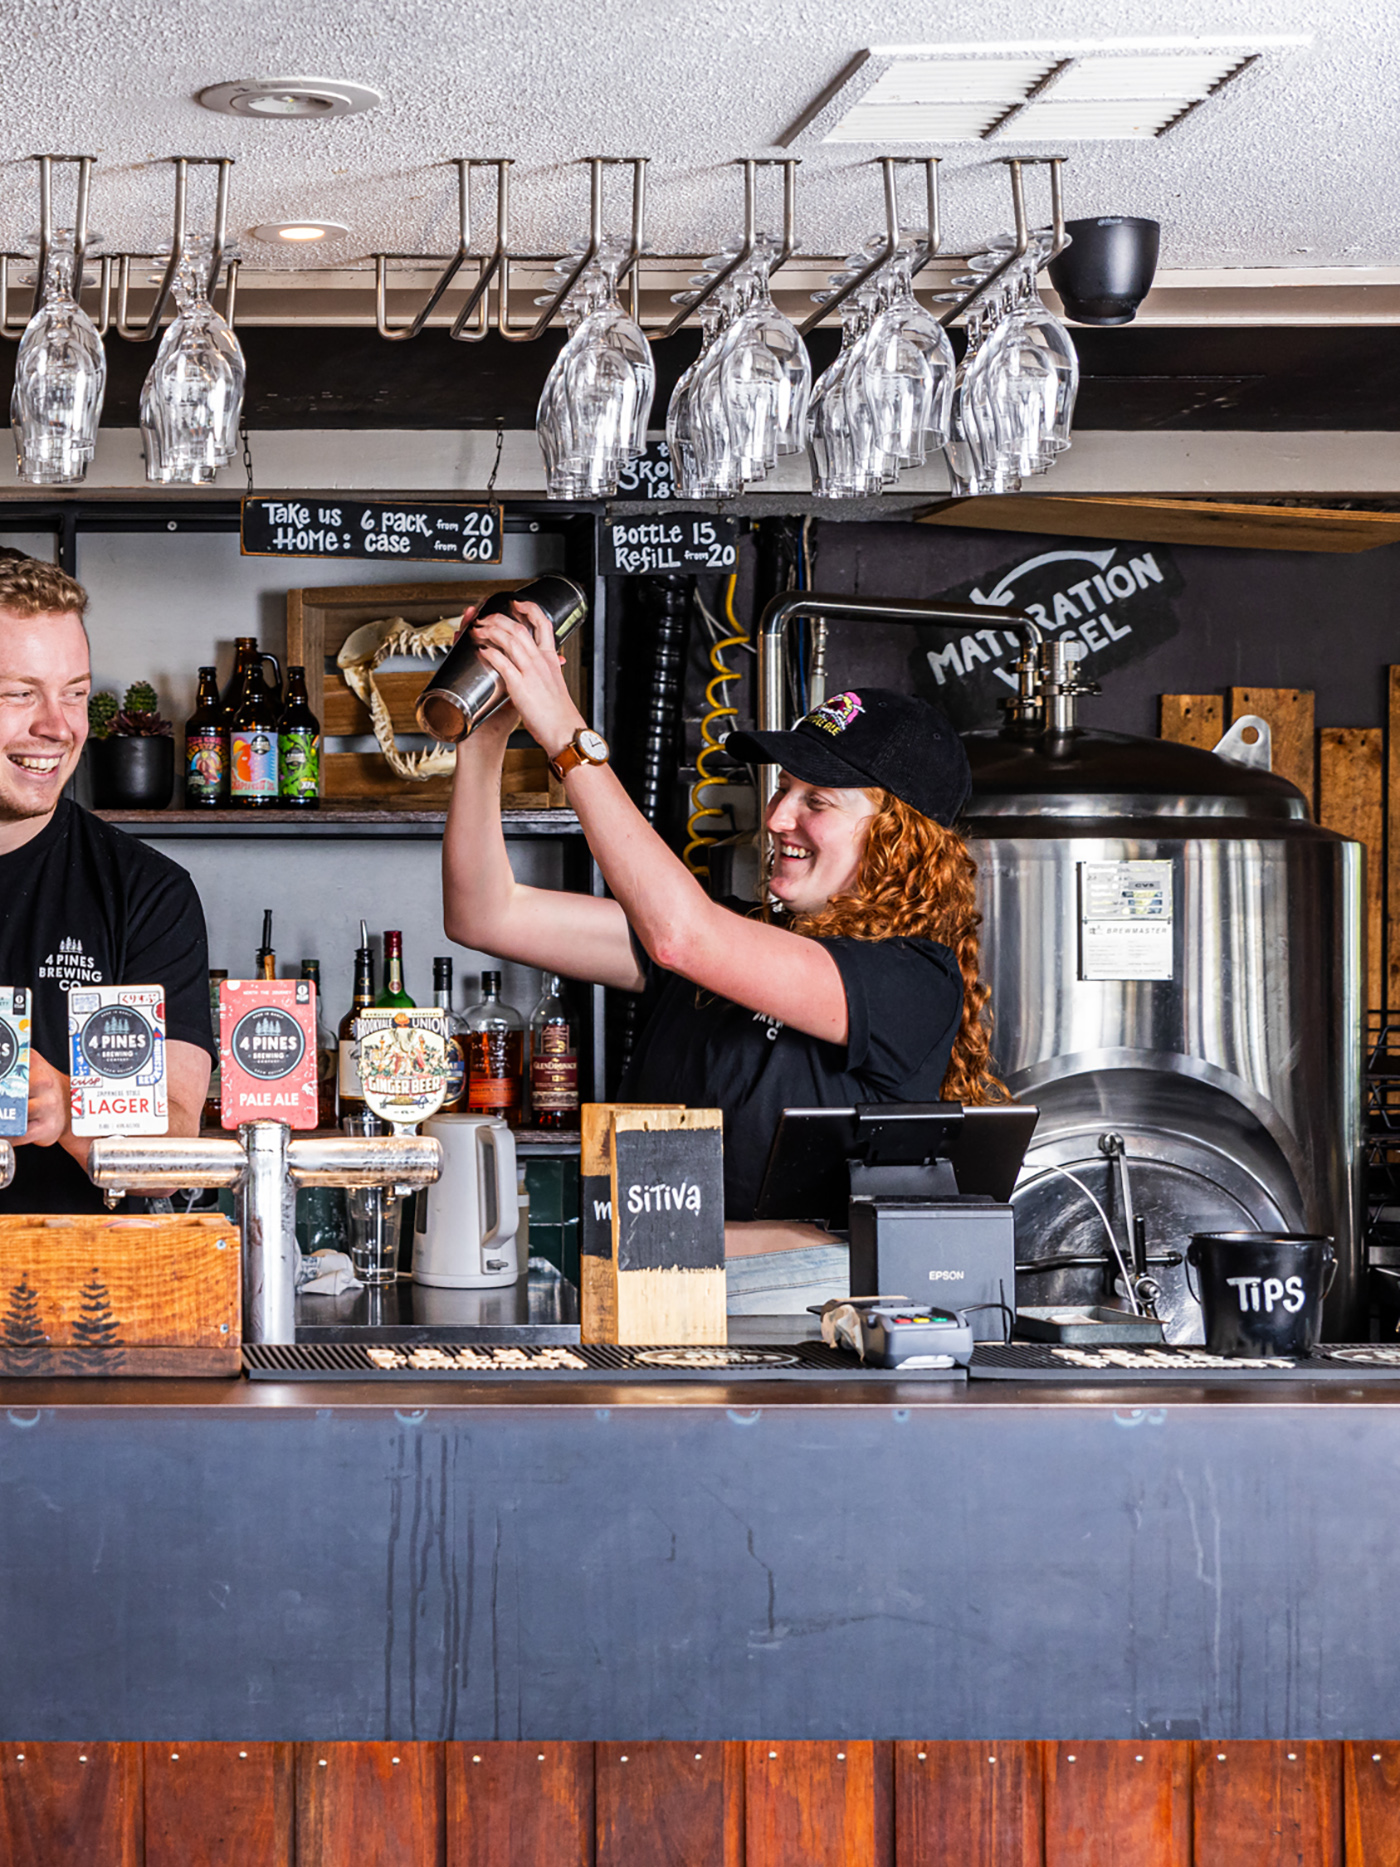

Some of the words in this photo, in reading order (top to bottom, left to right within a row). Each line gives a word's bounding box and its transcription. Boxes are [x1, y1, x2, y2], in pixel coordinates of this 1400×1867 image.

[318, 508, 342, 526] us
[360, 510, 375, 531] 6
[381, 512, 433, 537] pack
[436, 519, 458, 531] from
[462, 512, 494, 536] 20
[693, 522, 716, 545] 15
[364, 533, 411, 553] case
[433, 540, 457, 551] from
[462, 537, 493, 560] 60
[684, 550, 709, 560] from
[706, 543, 736, 567] 20
[993, 613, 1132, 691] VSEL
[45, 954, 53, 965] 4
[56, 954, 94, 969] PINES
[39, 967, 102, 983] BREWING
[411, 1017, 450, 1041] UNION
[88, 1035, 98, 1049] 4
[102, 1034, 146, 1049] PINES
[239, 1036, 250, 1050] 4
[252, 1036, 297, 1050] PINES
[368, 1076, 410, 1094] GINGER
[411, 1075, 441, 1094] BEER
[89, 1098, 149, 1114] LAGER
[239, 1093, 272, 1106] PALE
[274, 1093, 299, 1106] ALE
[928, 1270, 965, 1280] EPSON
